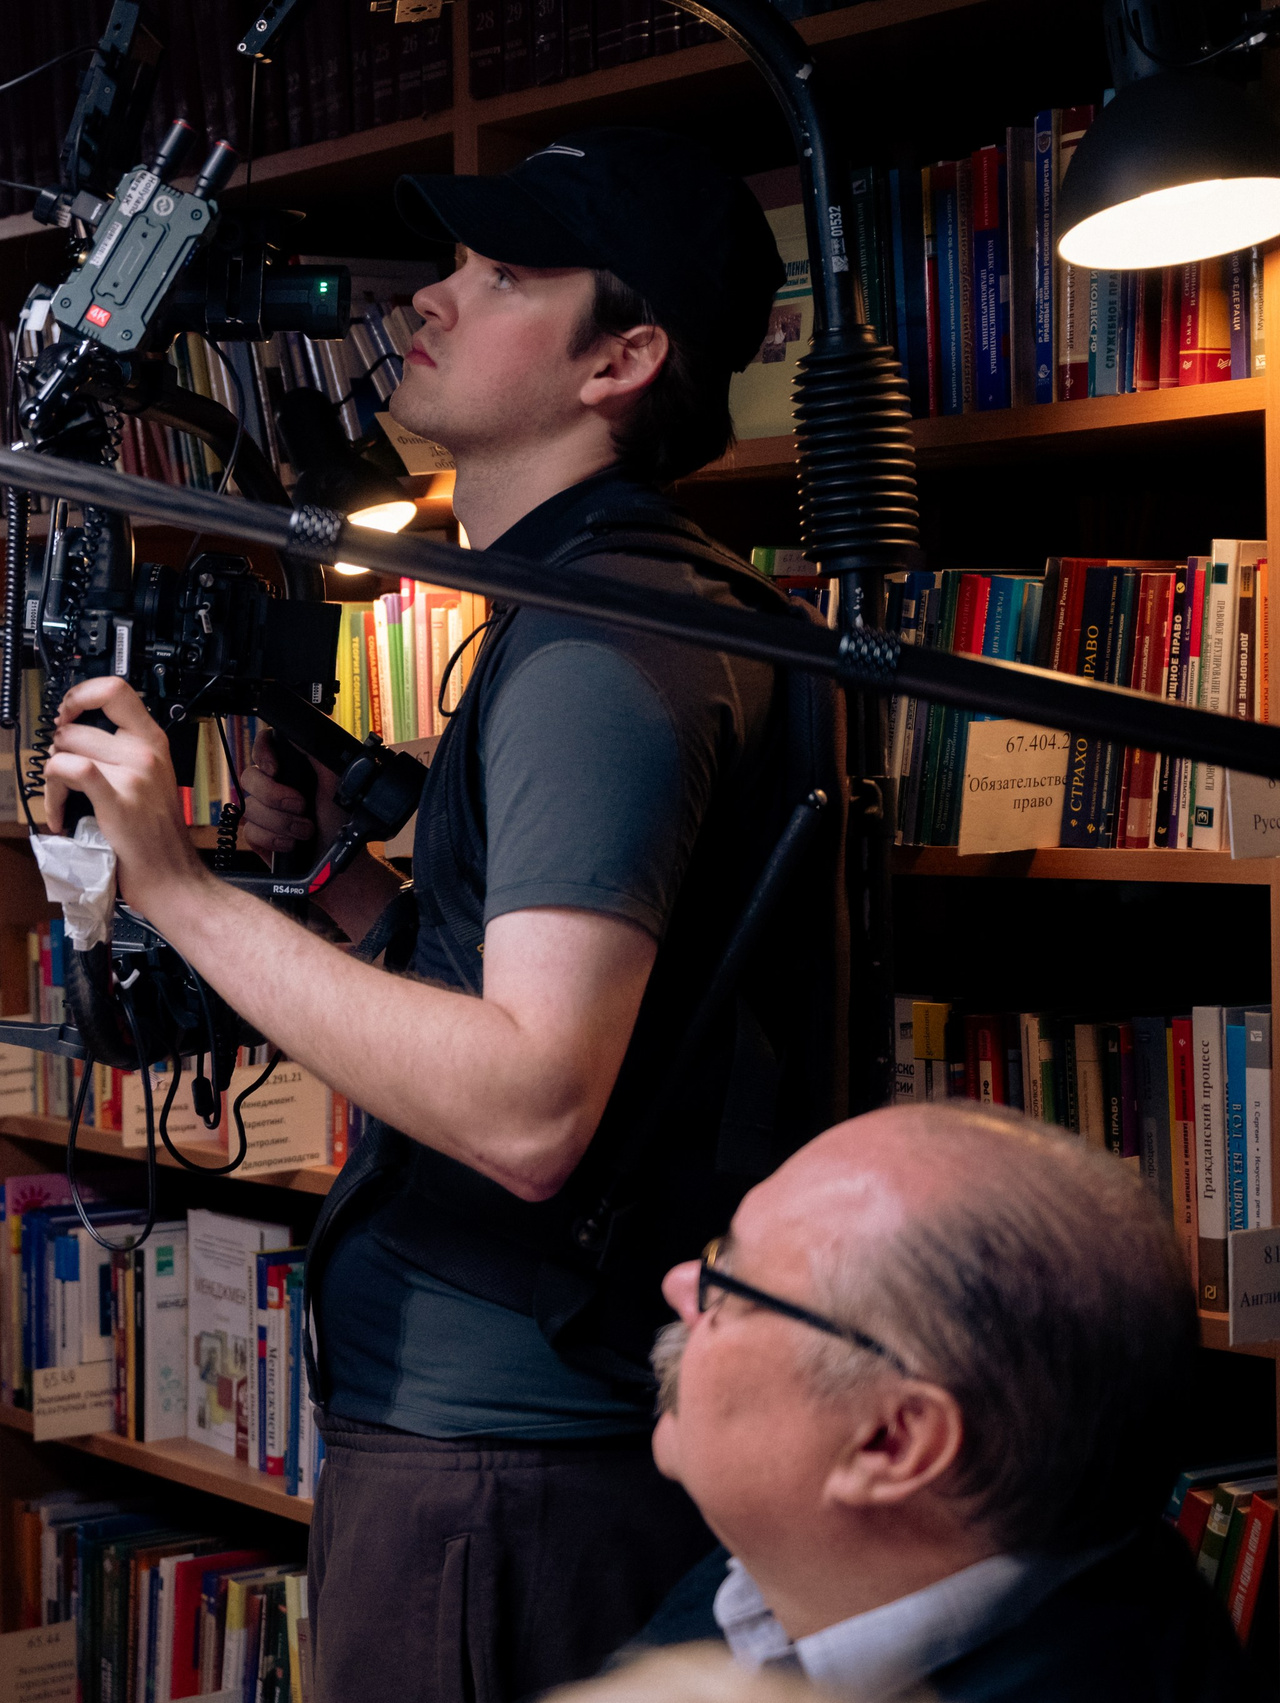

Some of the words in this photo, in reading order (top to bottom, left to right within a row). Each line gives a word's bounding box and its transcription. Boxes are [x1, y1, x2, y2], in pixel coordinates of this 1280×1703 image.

[1042, 158, 1050, 211] ГОСУДАРСТВА
[829, 205, 843, 237] 01532
[987, 240, 995, 271] КОДЕКС
[988, 273, 995, 285] ОБ
[90, 306, 108, 323] 4K
[980, 269, 989, 351] ПРАВОНАРУШЕНИЯХ
[1090, 282, 1098, 331] КОДЕКС
[988, 287, 997, 374] АДМИНИСТРАТИВНЫХ
[1091, 334, 1097, 353] РФ
[1105, 300, 1117, 369] СЛУЖЕБНОЕ
[1059, 577, 1069, 606] России
[992, 591, 1004, 654] ГРАЖДАНСКИЙ
[1058, 607, 1066, 630] праве
[1171, 614, 1182, 654] ПРАВО
[1214, 600, 1225, 635] ПРАВОВОЕ
[352, 637, 361, 674] ТЕОРИЯ
[368, 636, 379, 696] СОЦИАЛЬНАЯ
[1212, 638, 1223, 695] РЕГУЛИРОВАНИЕ
[1239, 633, 1249, 699] ДОГОВОРНОЕ
[373, 697, 381, 730] РАБОТА
[942, 738, 952, 766] Закону
[1006, 732, 1070, 753] 67.404.2
[1070, 738, 1088, 812] СТРАХО
[1013, 796, 1053, 812] право
[1201, 1039, 1214, 1099] процесс
[983, 1080, 990, 1095] РФ
[1111, 1097, 1120, 1135] ПРАВО
[1233, 1103, 1242, 1111] В
[246, 1137, 291, 1149] онтролинг.
[1232, 1114, 1243, 1138] СУД
[1253, 1111, 1261, 1144] Сергеич
[241, 1151, 320, 1170] Делопроизводство
[1145, 1132, 1155, 1178] процесс
[1202, 1103, 1215, 1199] Гражданский
[1233, 1152, 1243, 1173] БЕЗ
[1254, 1156, 1262, 1196] Искусство
[1253, 1199, 1261, 1218] речи
[266, 1344, 278, 1450] Менеджмент
